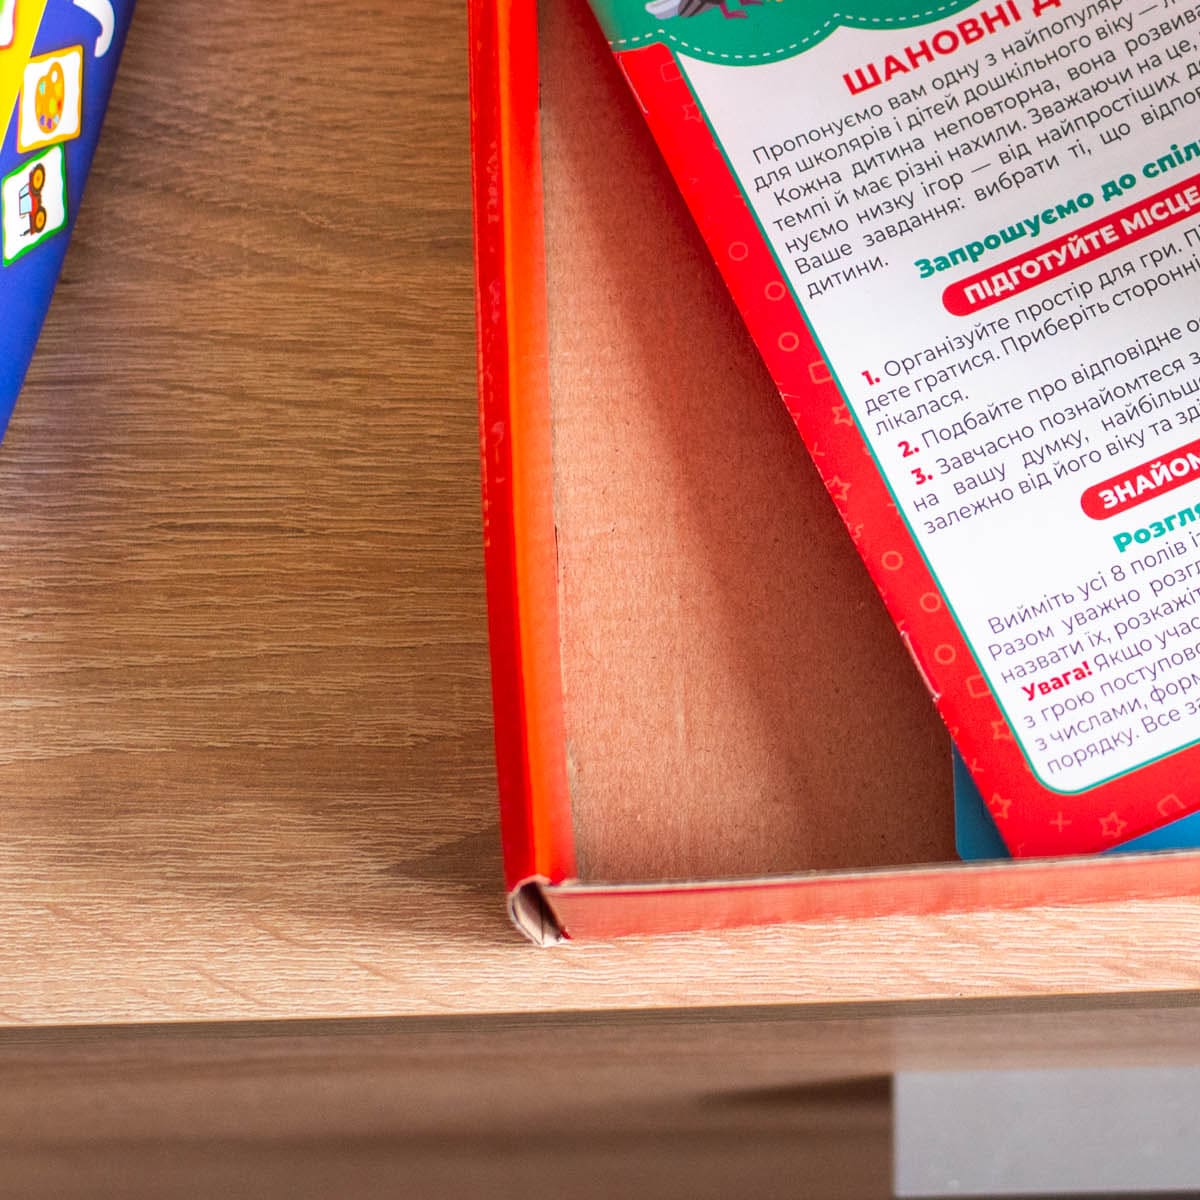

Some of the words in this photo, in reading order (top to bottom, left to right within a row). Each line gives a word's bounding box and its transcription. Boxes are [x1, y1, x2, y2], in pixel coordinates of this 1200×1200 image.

[751, 103, 884, 165] Пропонуємо
[886, 83, 928, 111] вам
[930, 58, 980, 91] одну
[983, 52, 998, 67] з
[772, 170, 843, 207] Кожна
[850, 136, 926, 179] дитина
[932, 78, 1061, 143] неповторна,
[1066, 48, 1117, 82] вона
[793, 242, 854, 275] Ваше
[861, 196, 966, 248] завдання:
[972, 153, 1061, 202] вибрати
[1066, 137, 1092, 159] ті,
[1098, 121, 1132, 145] що
[912, 191, 1095, 280] Запрошуємо
[1100, 172, 1138, 203] до
[806, 255, 889, 300] дитини.
[860, 368, 882, 387] 1.
[883, 316, 1011, 377] Організуйте
[1013, 280, 1094, 324] простір
[1097, 260, 1137, 291] для
[1138, 241, 1183, 269] гри.
[963, 223, 1120, 312] ПІДГОТУЙТЕ
[864, 384, 912, 417] дете
[913, 348, 1001, 393] гратися.
[999, 301, 1111, 356] Приберіть
[896, 439, 921, 459] 2.
[920, 396, 1024, 449] Подбайте
[1026, 377, 1068, 404] про
[1070, 326, 1183, 385] відповідне
[909, 466, 934, 486] 3.
[934, 424, 1035, 475] Завчасно
[1038, 357, 1187, 432] познайомтеся
[912, 492, 941, 513] на
[952, 462, 1006, 496] вашу
[1020, 428, 1090, 470] думку,
[922, 487, 1015, 535] залежно
[1017, 471, 1053, 495] від
[1052, 449, 1103, 480] його
[1104, 427, 1145, 457] віку
[1147, 417, 1174, 436] та
[986, 591, 1075, 635] Вийміть
[1076, 570, 1108, 602] усі
[1109, 563, 1127, 582] 8
[1129, 540, 1188, 575] полів
[987, 624, 1055, 662] Разом
[1060, 588, 1141, 636] уважно
[1000, 639, 1085, 684] назвати
[1086, 630, 1112, 648] їх,
[1020, 659, 1094, 703] Увага!
[1092, 638, 1153, 672] Якщо
[1046, 726, 1140, 774] порядку.
[1140, 708, 1182, 734] Все
